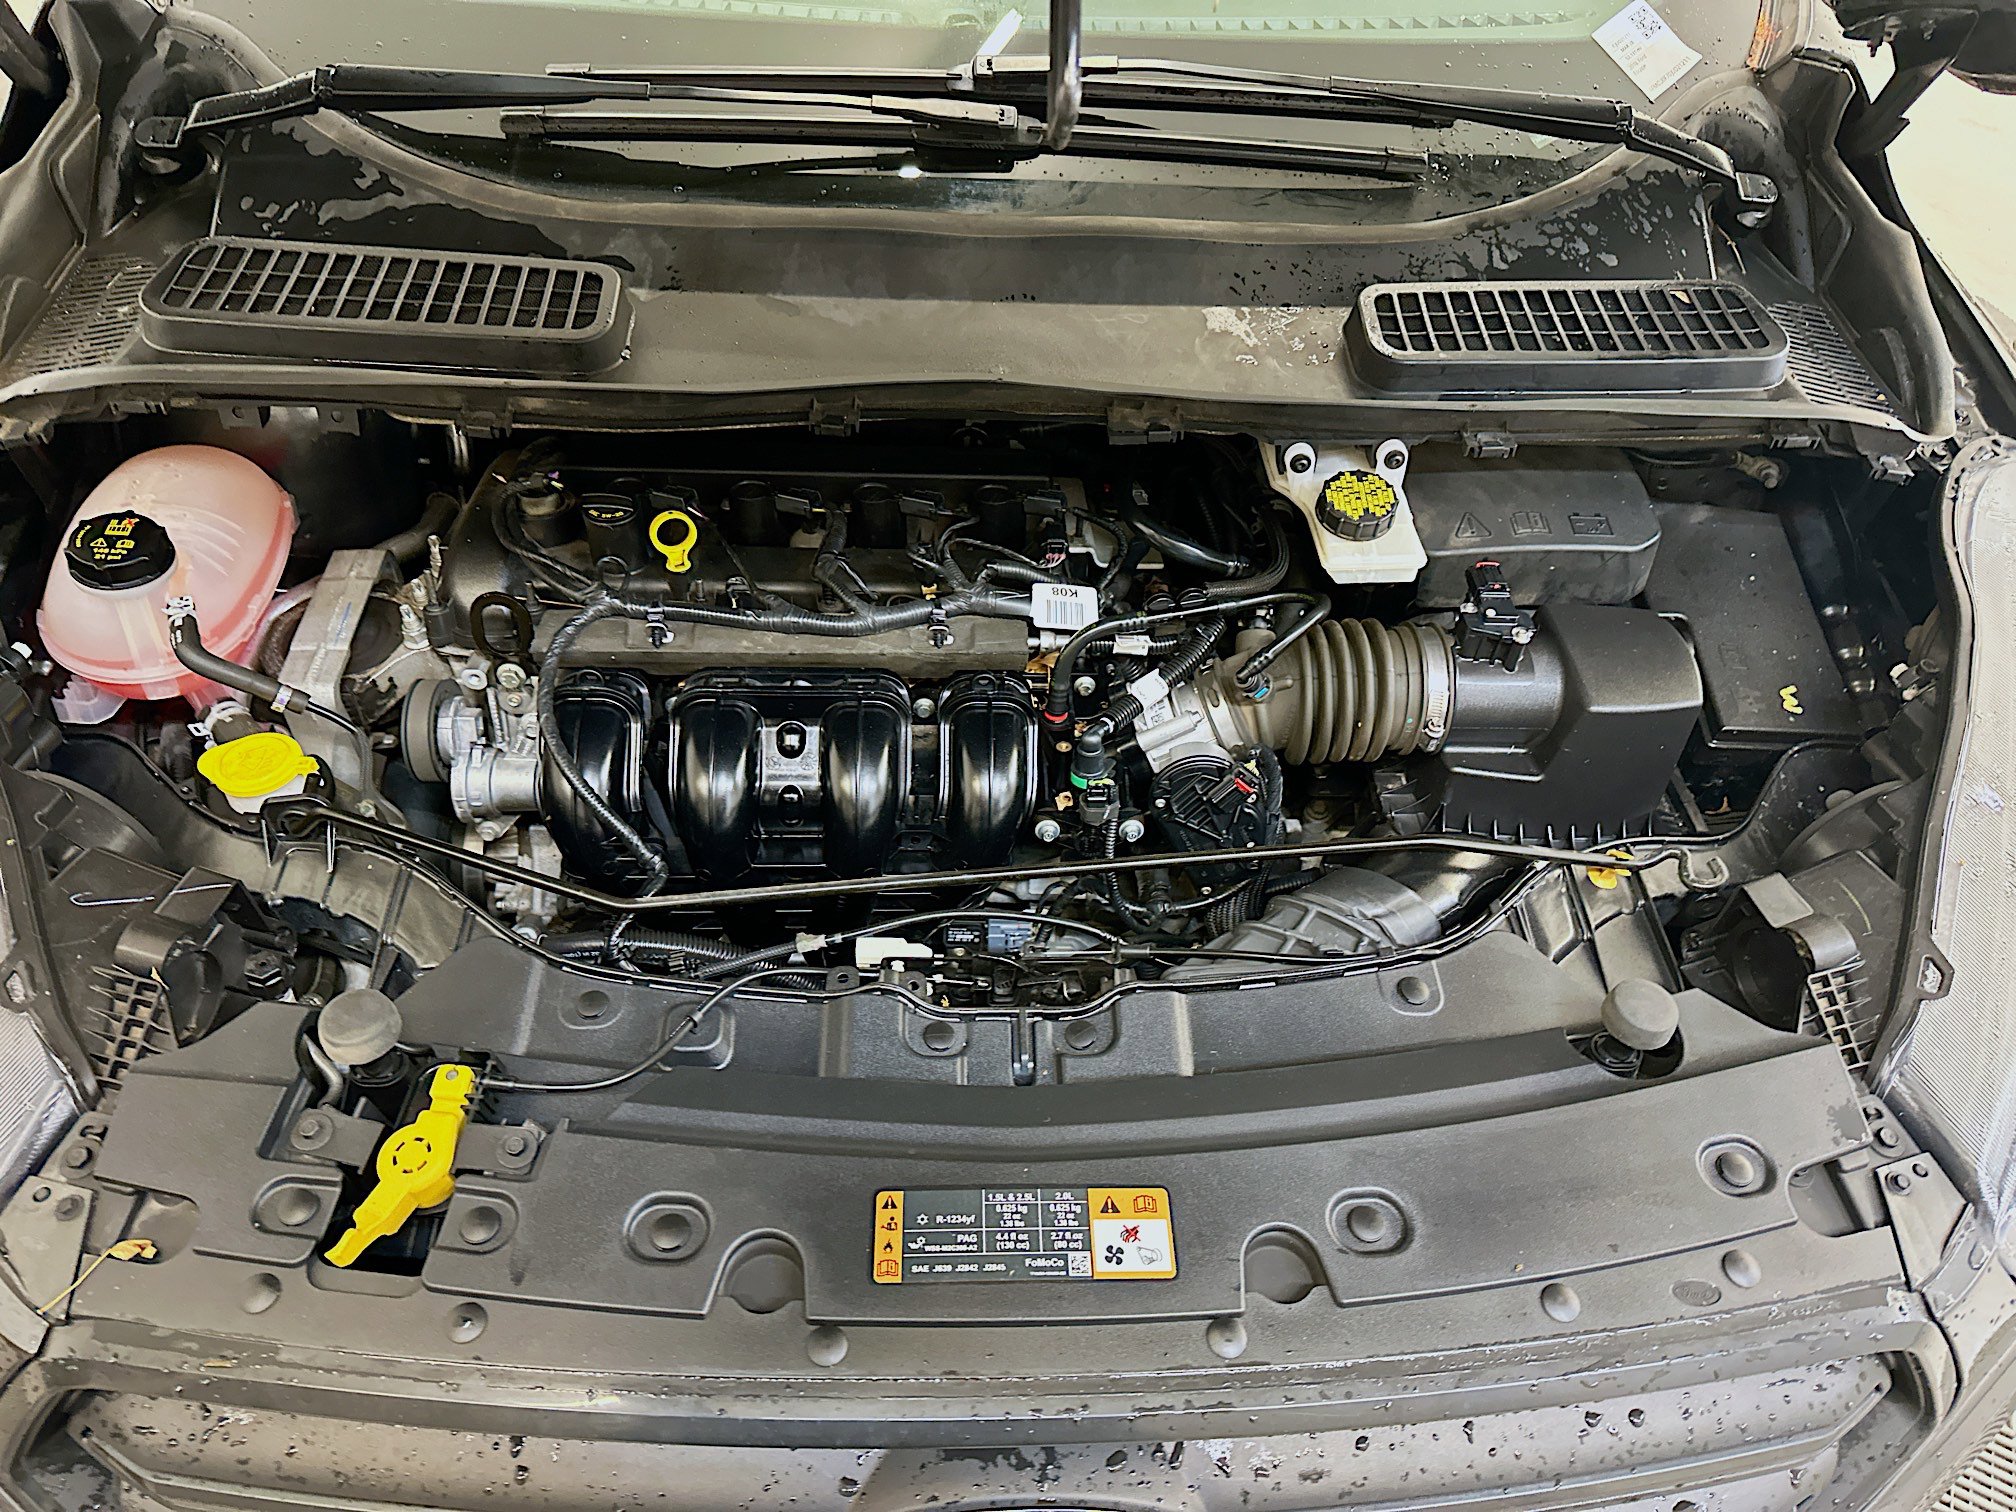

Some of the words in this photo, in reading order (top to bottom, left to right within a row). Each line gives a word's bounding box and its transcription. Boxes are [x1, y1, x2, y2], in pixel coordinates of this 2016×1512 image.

[1051, 586, 1078, 598] K08
[988, 1193, 1006, 1201] 1.5L
[1007, 1193, 1015, 1201] &
[1016, 1193, 1035, 1201] 2.5L
[1055, 1192, 1074, 1200] 2.0L
[1018, 1204, 1028, 1214] kg
[1071, 1204, 1081, 1213] kg
[936, 1214, 976, 1225] R-1234yf
[957, 1234, 978, 1242] PAG
[995, 1232, 1009, 1240] 4.4
[1010, 1232, 1016, 1240] fl
[1050, 1232, 1063, 1240] 2.7
[996, 1241, 1015, 1251] (130
[1016, 1241, 1030, 1250] cc)
[1068, 1240, 1083, 1250] cc)
[1025, 1258, 1065, 1267] FoMoCo
[911, 1265, 930, 1273] SAE
